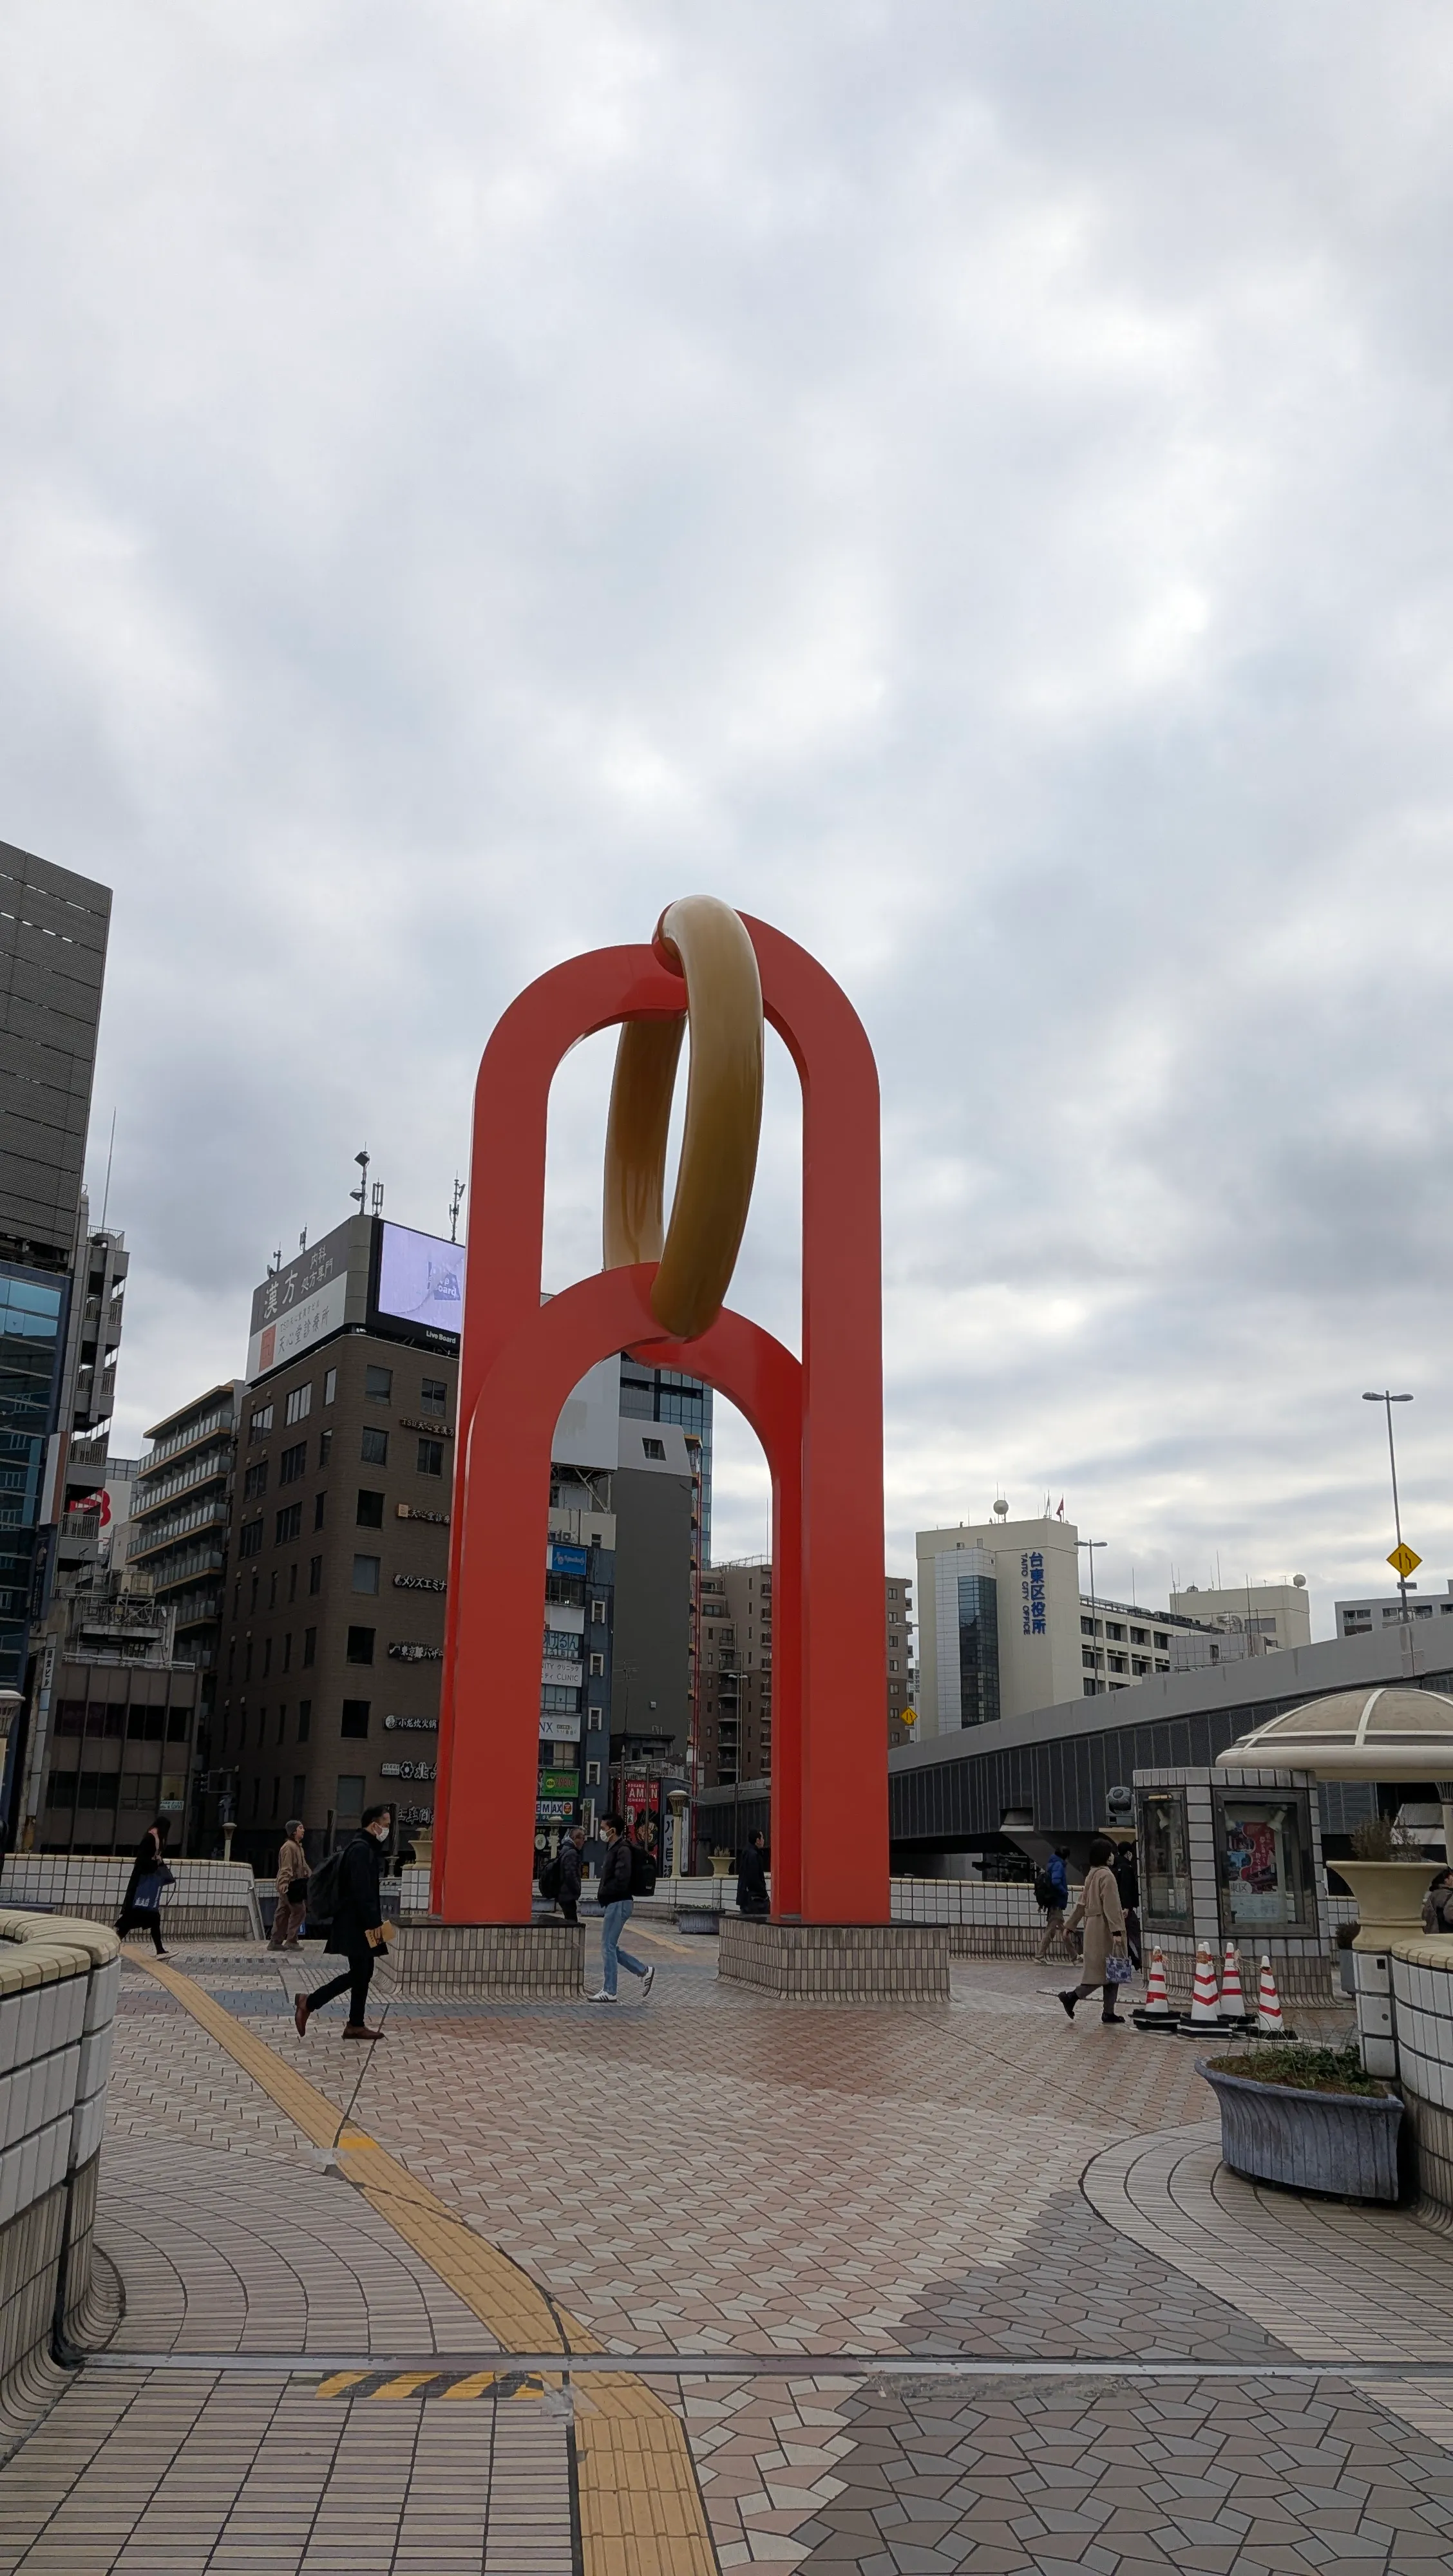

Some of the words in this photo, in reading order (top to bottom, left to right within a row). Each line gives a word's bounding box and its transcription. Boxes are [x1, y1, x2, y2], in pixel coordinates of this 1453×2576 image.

[310, 1245, 327, 1270] 内科
[263, 1269, 298, 1319] 漢方
[277, 1305, 330, 1356] 天心堂診療所
[426, 1330, 438, 1339] Live
[439, 1333, 456, 1344] Board
[1029, 1551, 1046, 1635] 台東区役所
[1022, 1605, 1030, 1635] OFFICE
[557, 1673, 579, 1681] CLINIC
[629, 1788, 658, 1799] AMN
